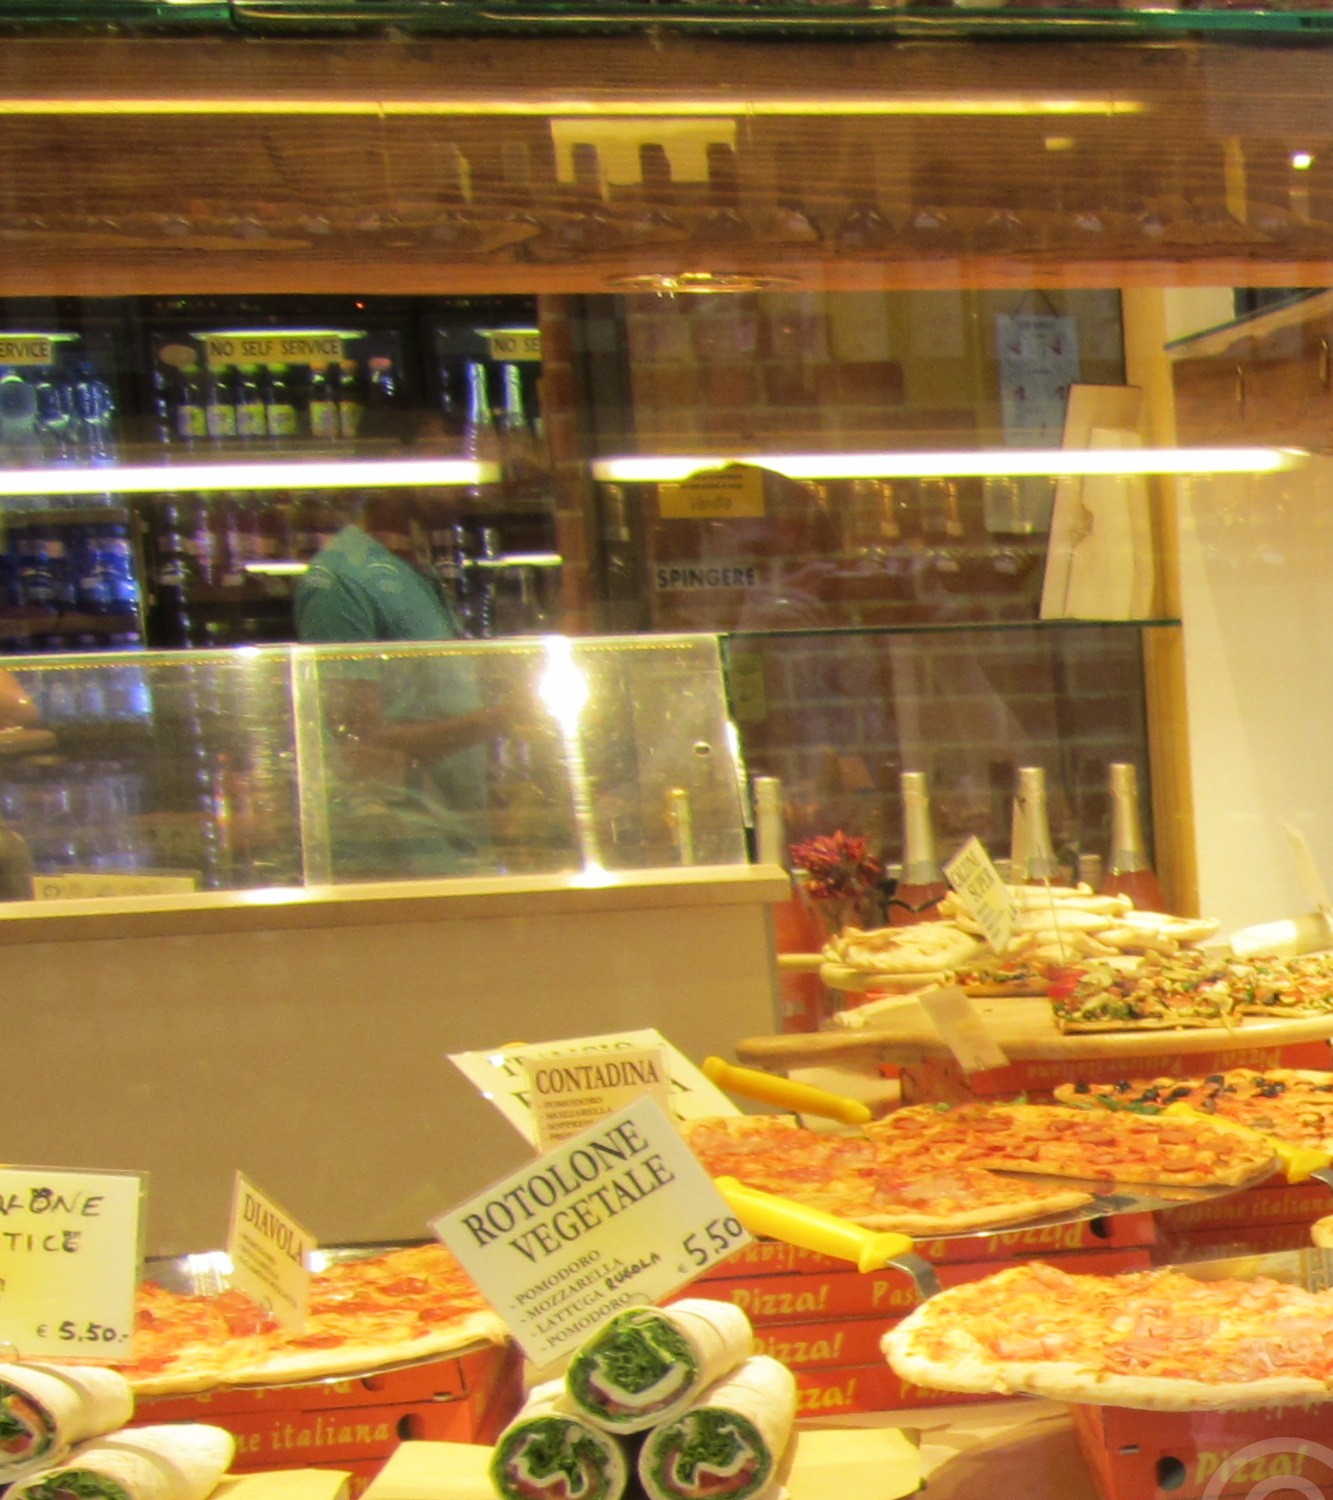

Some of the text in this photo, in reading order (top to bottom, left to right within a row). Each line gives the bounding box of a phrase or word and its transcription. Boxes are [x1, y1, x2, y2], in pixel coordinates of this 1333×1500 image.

[211, 339, 340, 356] NO SELF SERVICE
[657, 567, 755, 588] SPINGERE
[535, 1059, 660, 1094] CONTADINA
[460, 1119, 649, 1248] ROTOLONE
[243, 1193, 303, 1267] DIAVOLA
[507, 1154, 676, 1265] VEGETALE
[515, 1250, 600, 1305] POMODORO
[526, 1257, 626, 1320] MOZZARELLA
[731, 1284, 830, 1315] Pizza!
[536, 1290, 605, 1334] LATTUGA
[547, 1291, 633, 1347] POMODORO
[271, 1416, 390, 1450] italiana
[1195, 1444, 1313, 1485] Pizza!
